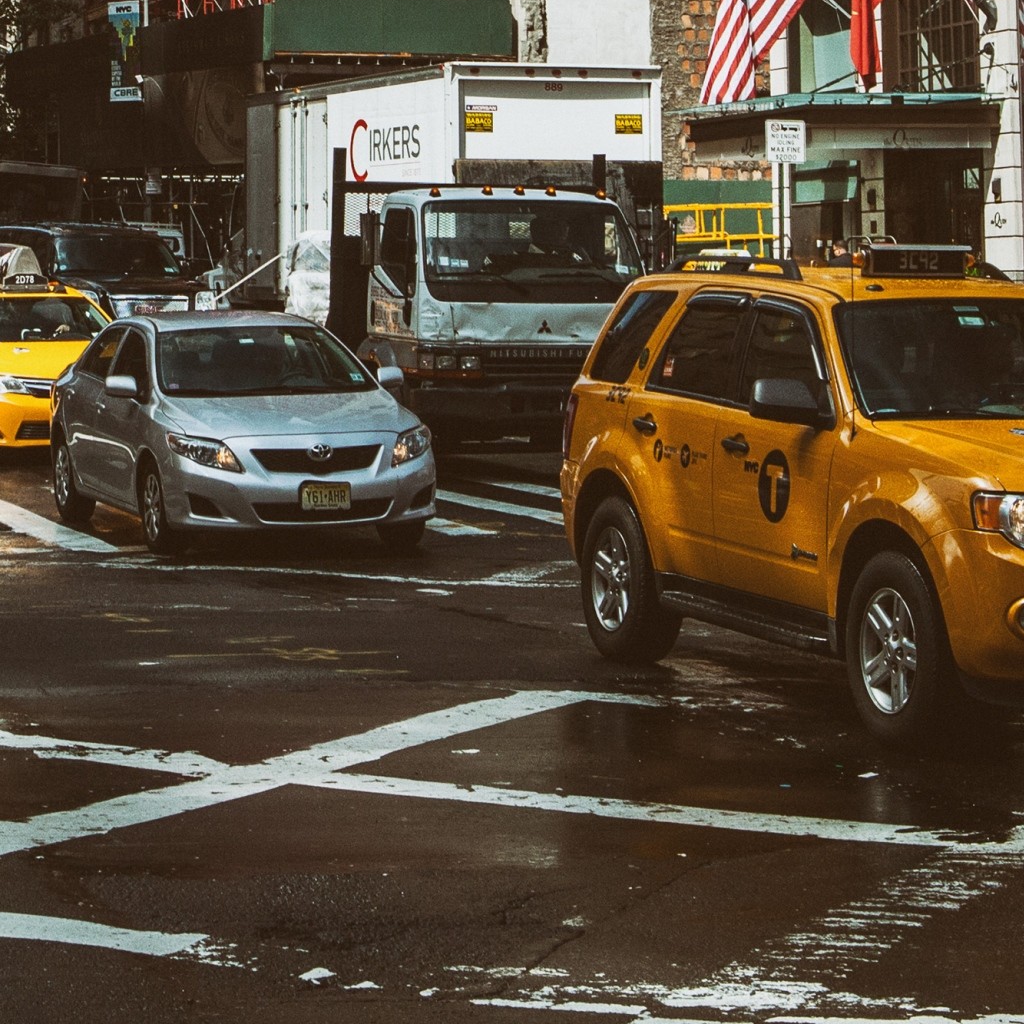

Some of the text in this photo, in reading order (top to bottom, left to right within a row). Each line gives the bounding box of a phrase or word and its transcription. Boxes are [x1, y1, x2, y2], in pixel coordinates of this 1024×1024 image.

[544, 83, 563, 91] 889
[114, 88, 138, 97] CBRE
[466, 117, 491, 125] BABACO
[350, 119, 421, 182] CIRKERS
[15, 275, 35, 284] 2D78
[490, 349, 563, 358] MITSUBISHI
[744, 460, 759, 474] NYC
